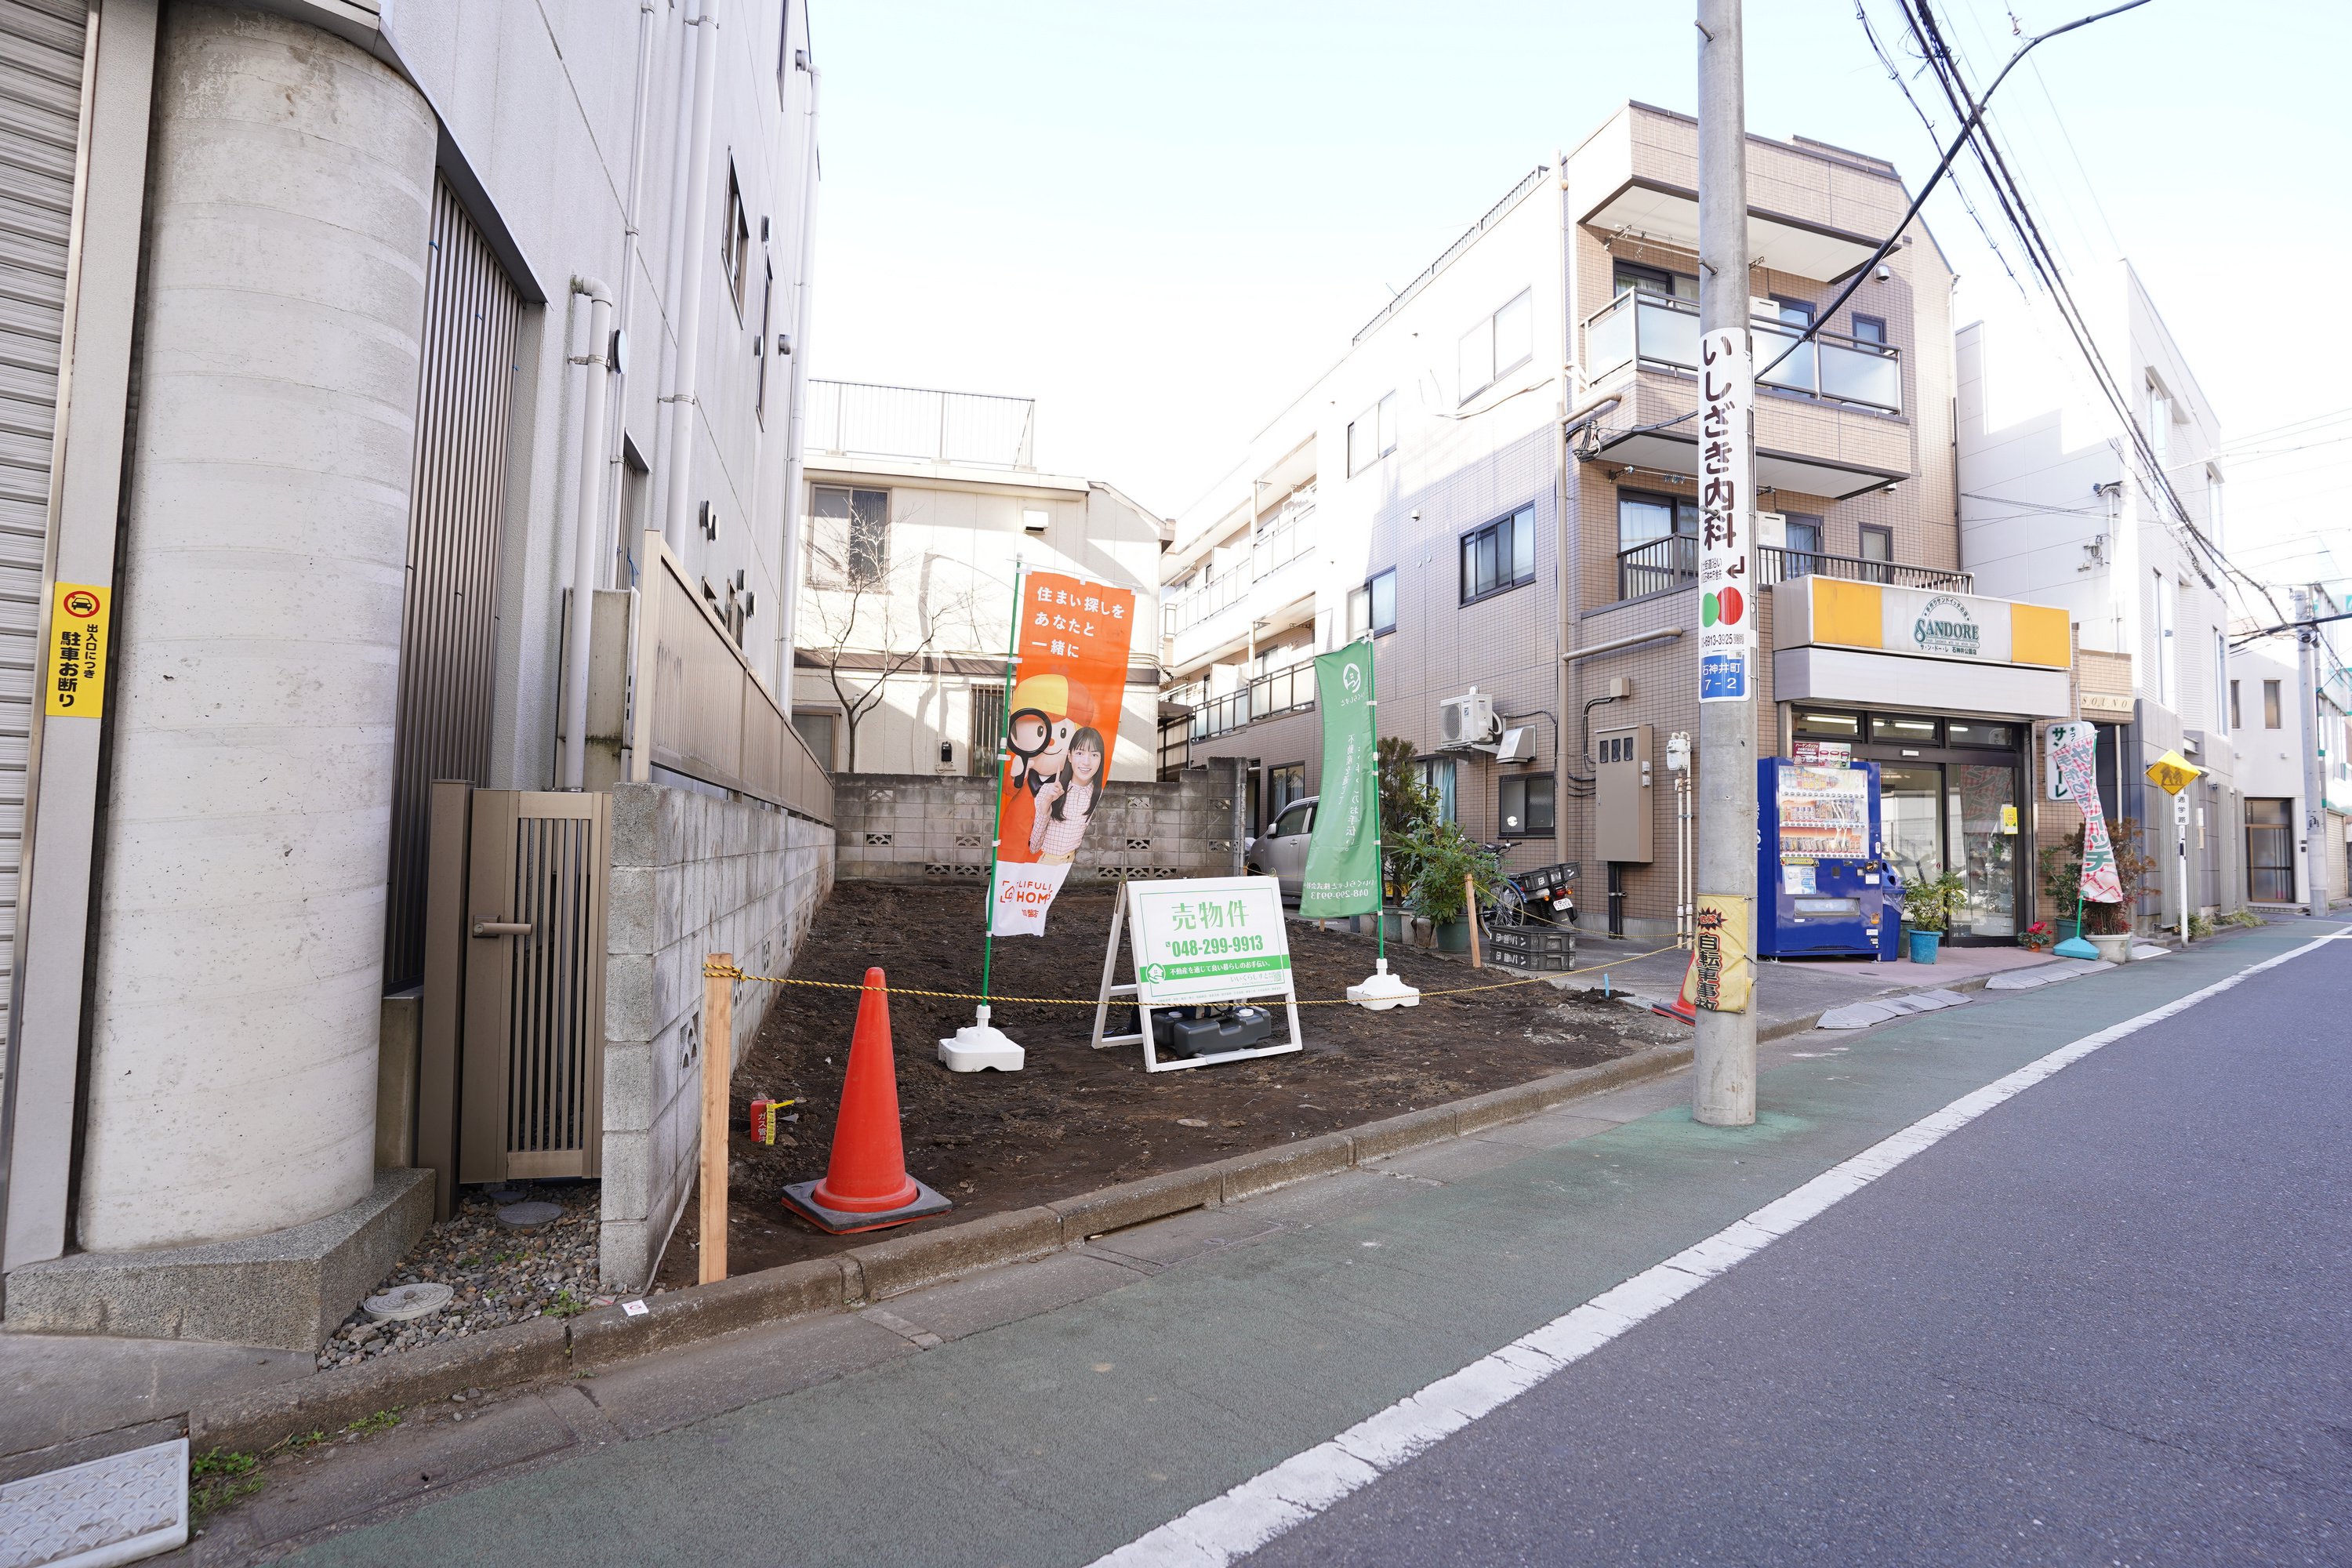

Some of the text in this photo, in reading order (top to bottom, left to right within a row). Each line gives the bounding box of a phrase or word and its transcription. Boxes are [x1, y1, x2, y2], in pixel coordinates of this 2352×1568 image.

[1703, 336, 1736, 551] いしざき内科
[1037, 586, 1125, 619] 住まい探しを
[1926, 597, 1969, 617] 手作りサンドイッチの店
[1034, 611, 1095, 637] あなたと
[1914, 619, 1980, 642] SANDORE
[84, 624, 98, 678] 出入口につき
[1032, 639, 1080, 659] 一緒に
[57, 631, 82, 707] 駐車お断り
[1702, 662, 1740, 676] 石神井町
[2052, 727, 2067, 798] サーレ
[1171, 900, 1250, 931] 売物件
[1699, 914, 1718, 924] 危険
[1172, 935, 1263, 957] 048-299-9913
[1170, 960, 1271, 976] 不動産を通じて良い暮らしのお手伝い。
[1230, 971, 1269, 982] いいくらしすと
